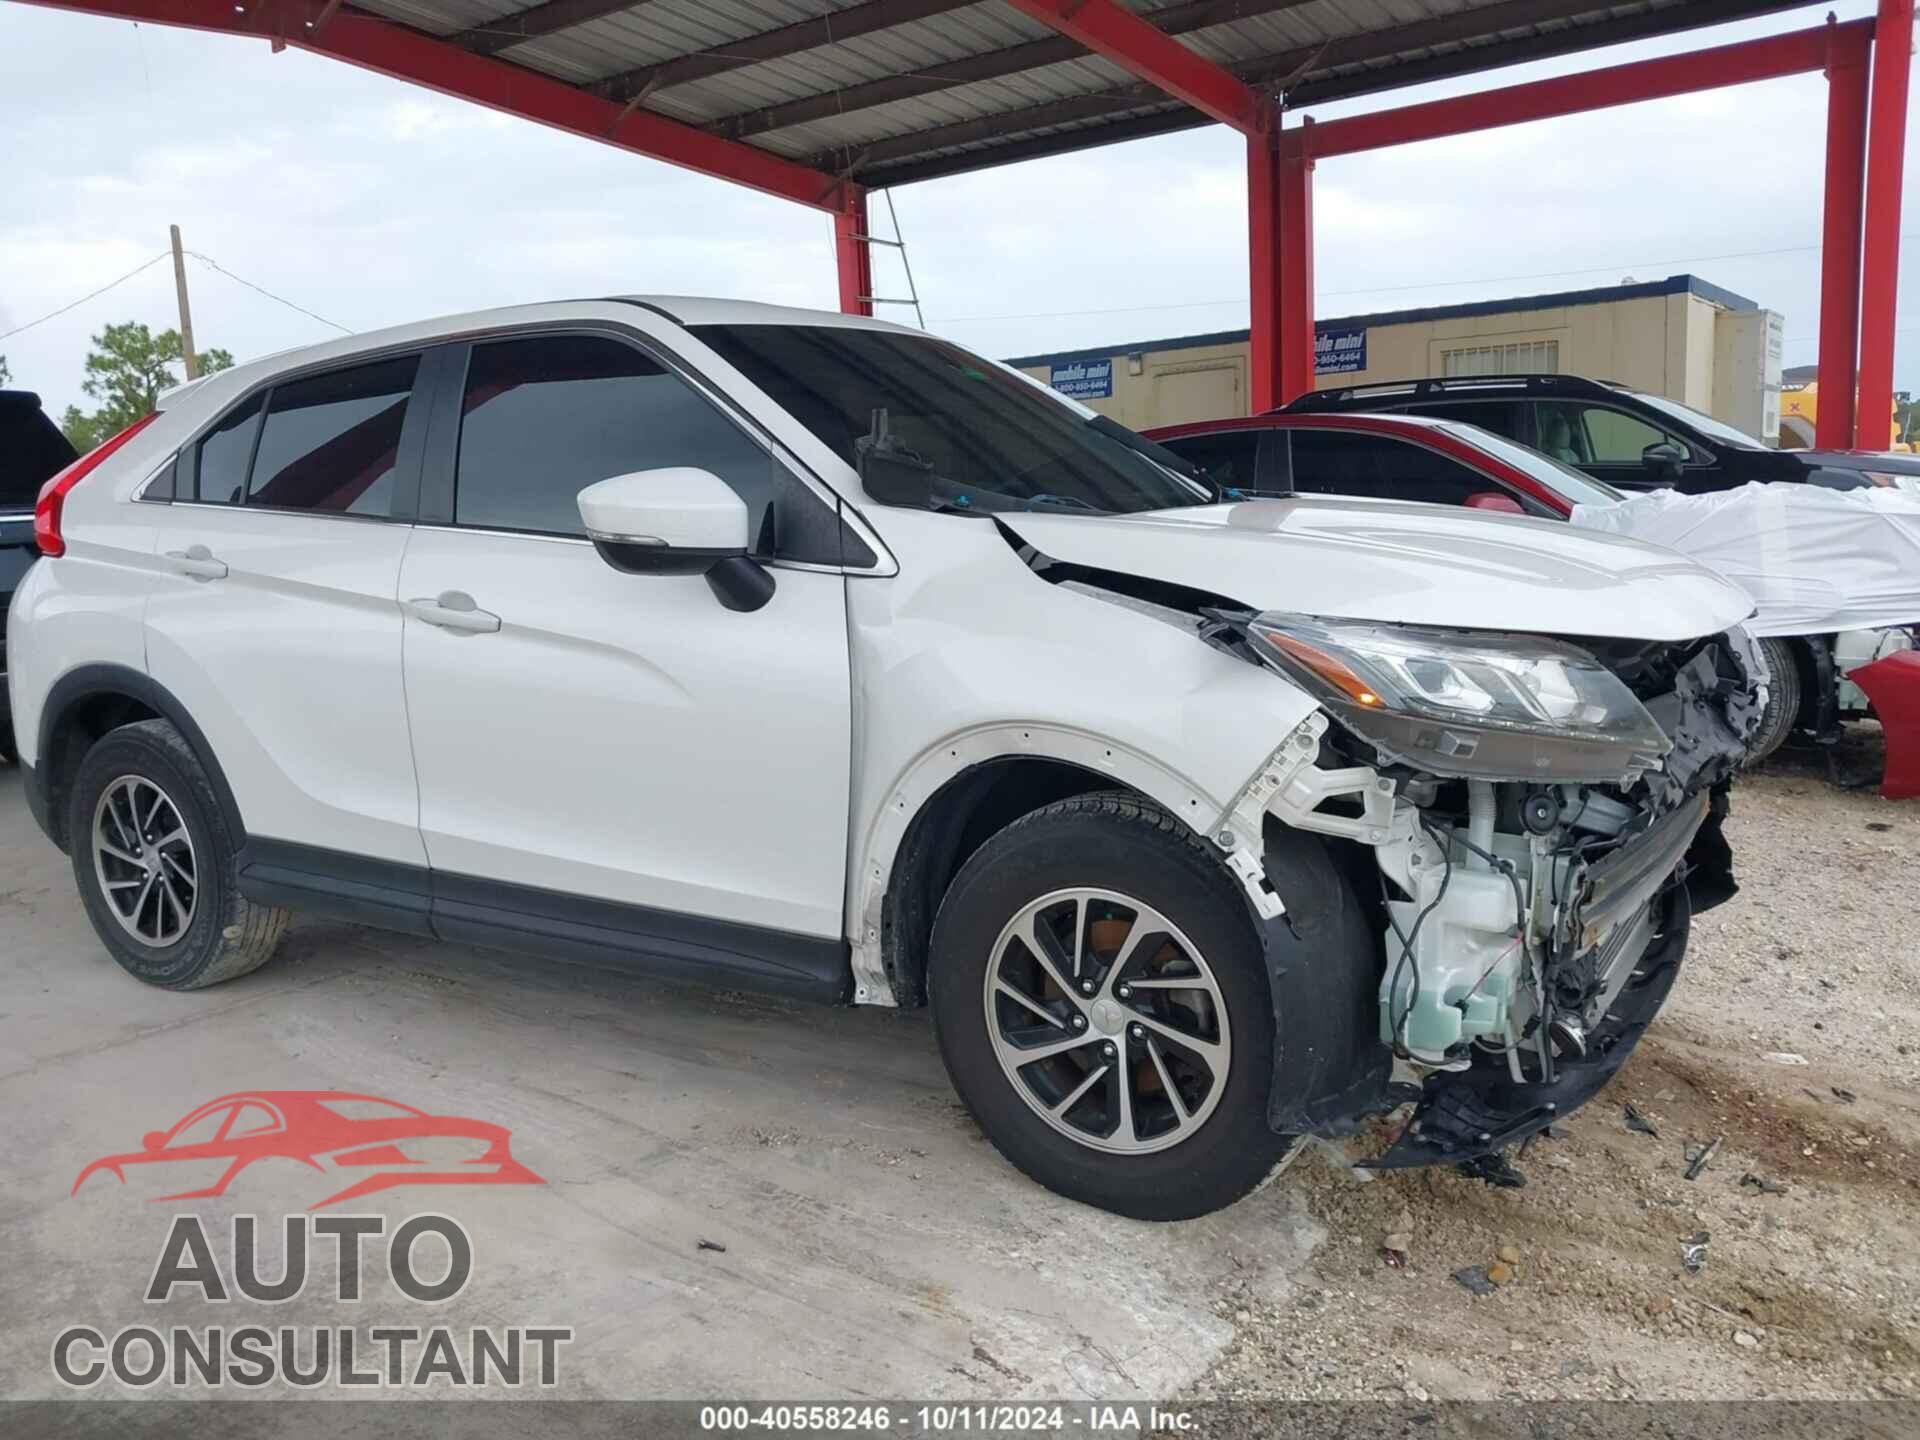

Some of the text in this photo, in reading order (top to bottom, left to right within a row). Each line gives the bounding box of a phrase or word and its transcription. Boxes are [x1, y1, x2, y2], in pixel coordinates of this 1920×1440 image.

[1313, 332, 1364, 352] bile mini
[1053, 362, 1111, 382] mobile mini
